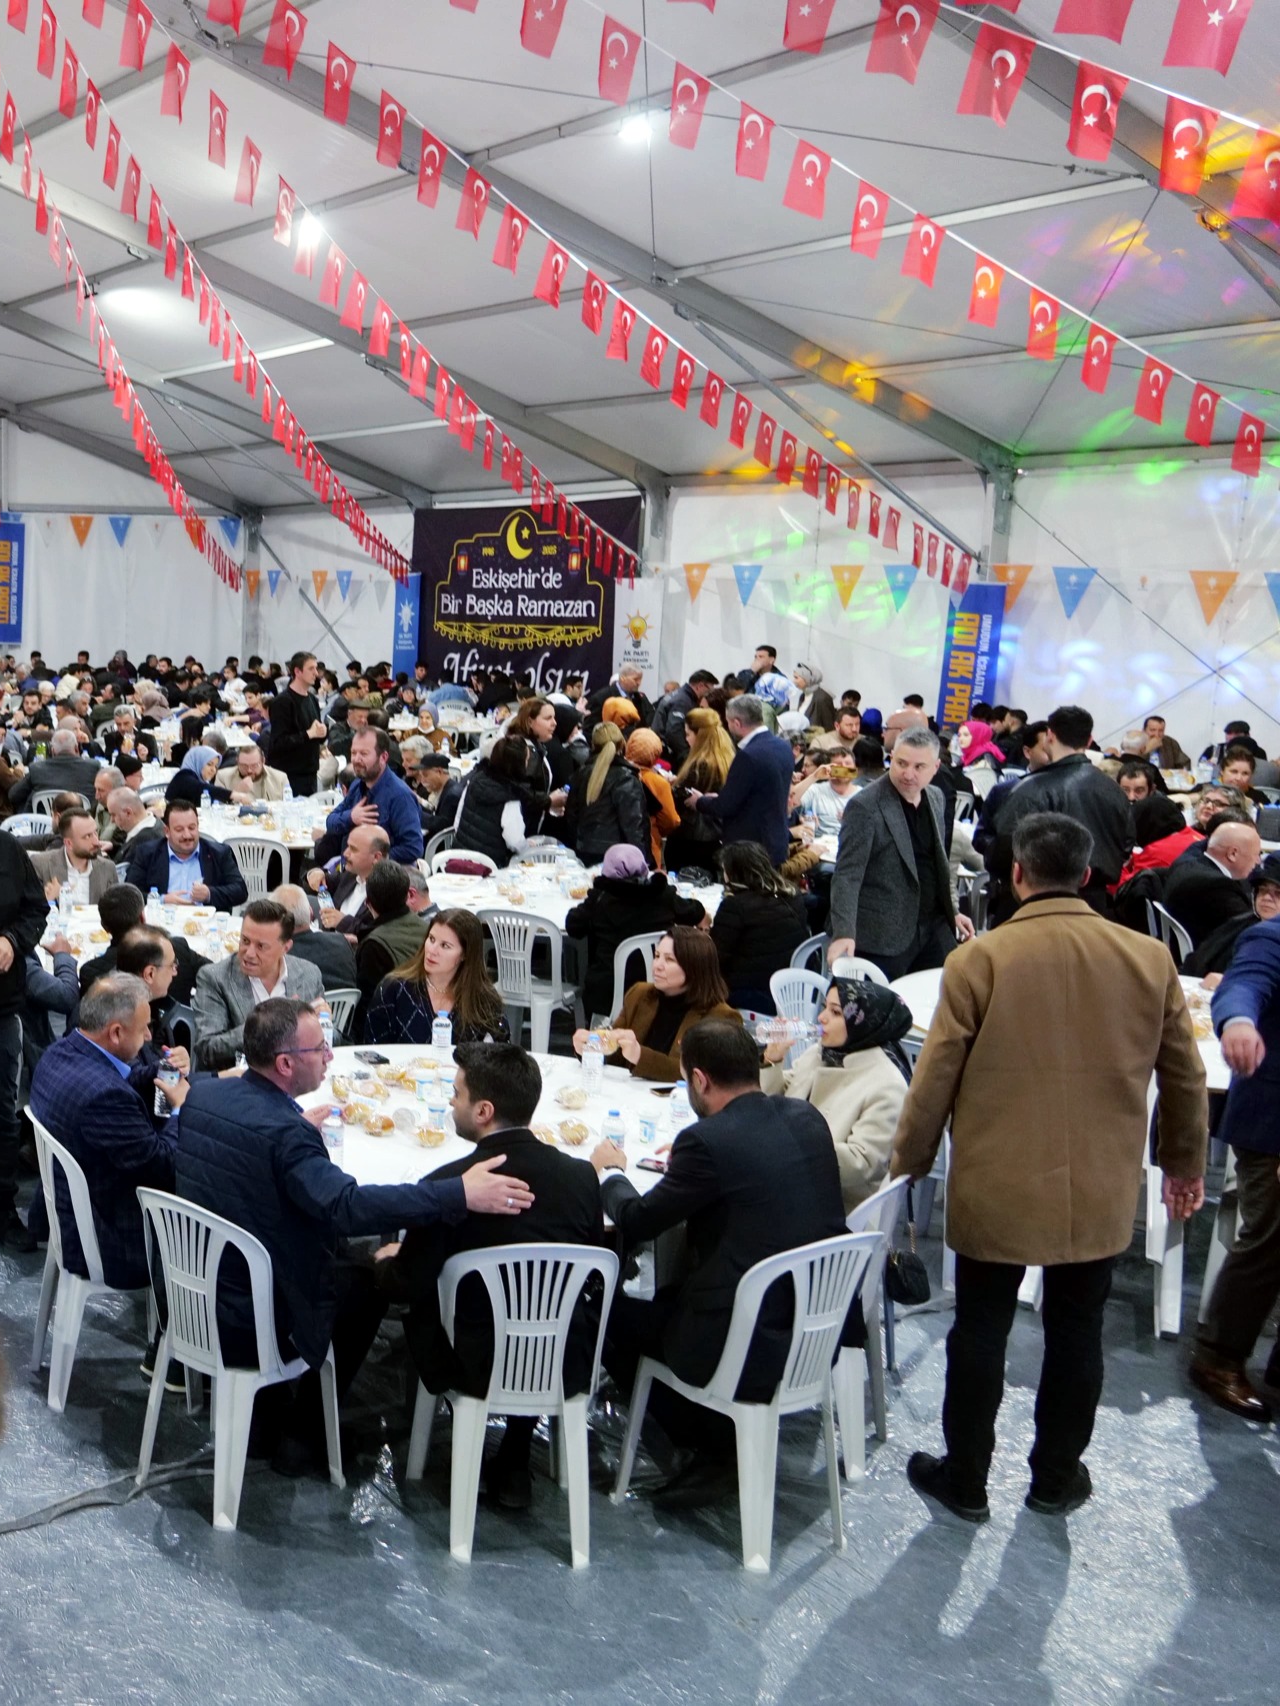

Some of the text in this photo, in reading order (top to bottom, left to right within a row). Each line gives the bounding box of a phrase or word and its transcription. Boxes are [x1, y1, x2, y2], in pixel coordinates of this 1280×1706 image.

[472, 566, 563, 594] Eskişehir'de
[440, 593, 596, 621] Bir Başka Ramazan
[952, 612, 980, 646] ADI
[948, 650, 975, 679] AK
